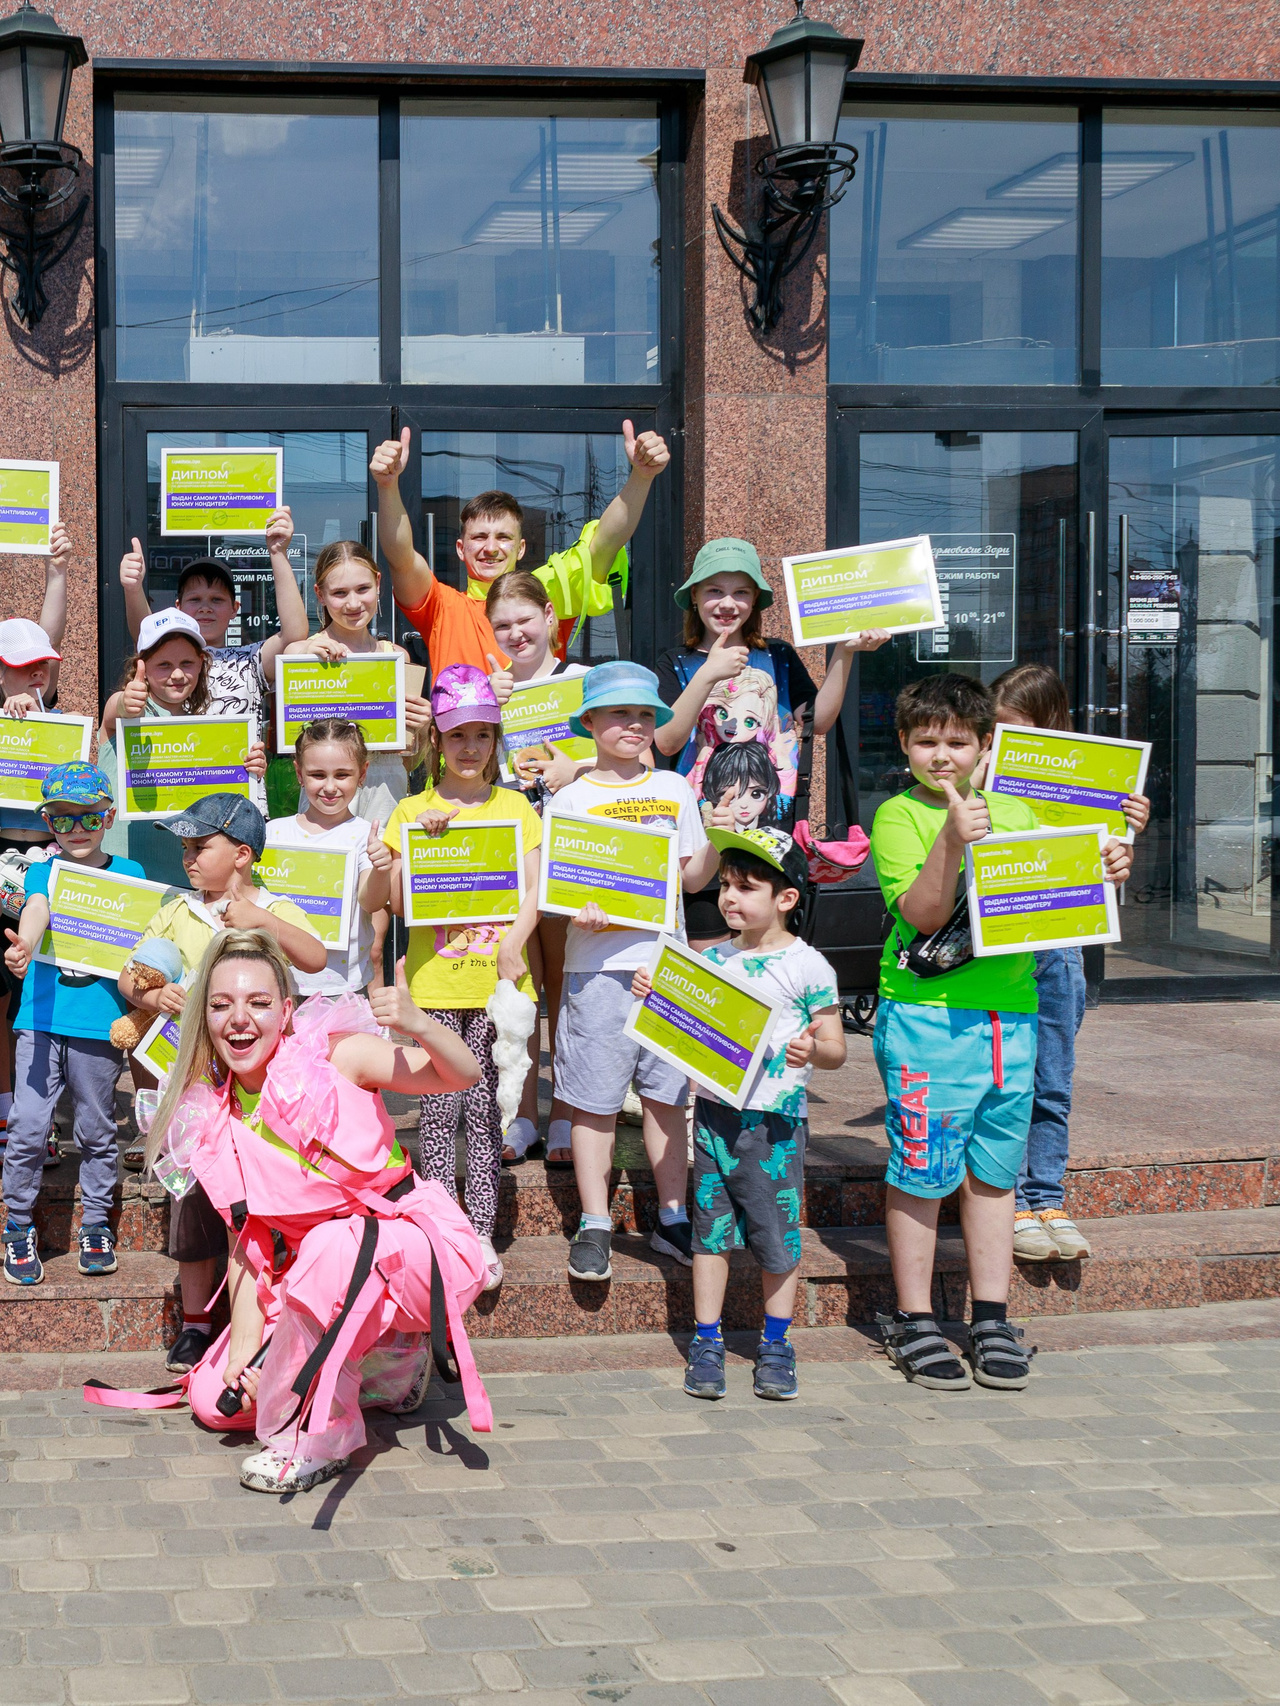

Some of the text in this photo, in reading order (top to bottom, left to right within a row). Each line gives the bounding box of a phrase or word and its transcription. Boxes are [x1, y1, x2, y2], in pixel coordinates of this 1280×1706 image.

[171, 470, 229, 481] ДИПЛОМ
[215, 546, 270, 561] Сормовски
[932, 545, 982, 559] ормовские
[801, 569, 867, 589] ДИПЛОМ
[288, 679, 348, 691] ДИПЛОМ
[130, 742, 195, 756] ДИПЛОМ
[1003, 750, 1077, 769] ДИПЛОМ
[998, 786, 1070, 800] ЮНОМУ КОНДИТЕРУ
[999, 778, 1118, 800] ВЫДАН САМОМУ ТАЛАНТЛИВОМУ
[604, 805, 672, 815] GENERATION
[412, 846, 470, 860] ДИПЛОМ
[554, 836, 618, 856] ДИПЛОМ
[553, 864, 654, 887] ВЫДАН САМОМУ ТАЛАНТЛИВОМУ
[980, 860, 1047, 880] ДИПЛОМ
[553, 871, 615, 886] ЮНОМУ КОНДИТЕРУ
[59, 889, 125, 912] ДИПЛОМ
[1009, 895, 1038, 903] САМОМУ
[1039, 889, 1091, 899] ТАЛАНТЛИВОМУ
[985, 901, 1051, 913] ЮНОМУ КОНДИТЕРУ
[53, 916, 106, 932] ВЫДАН САМОМУ
[52, 923, 117, 942] ЮНОМУ КОНДИТЕРУ
[452, 960, 465, 970] of
[658, 966, 717, 1007] ДИПЛОМ
[648, 1000, 702, 1037] ЮНОМУ КОНДИТЕРУ
[650, 994, 741, 1054] ВЫДАН САМОМУ ТАЛАНТЛИВОМУ
[901, 1064, 929, 1169] HEAT
